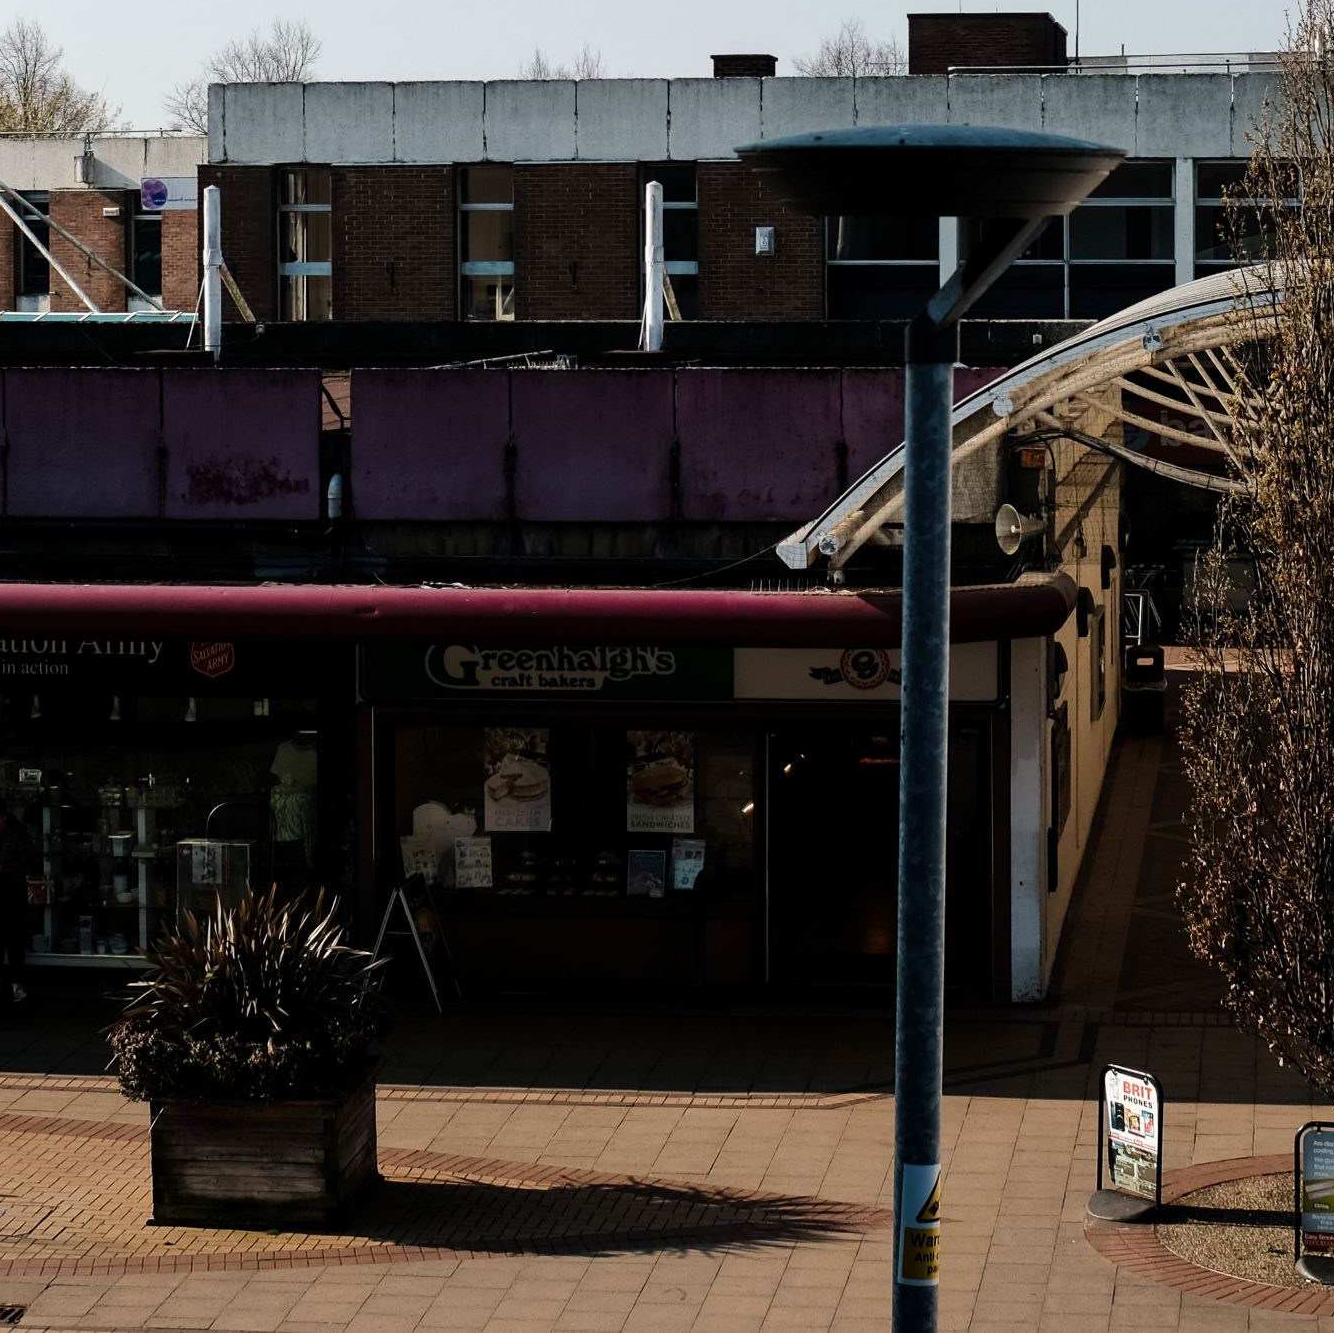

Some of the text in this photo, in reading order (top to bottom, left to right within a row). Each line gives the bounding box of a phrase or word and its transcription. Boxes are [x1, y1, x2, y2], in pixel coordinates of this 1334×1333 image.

[1, 659, 16, 674] in
[21, 659, 69, 675] action
[207, 649, 230, 671] ARMY
[491, 673, 596, 688] craft bakers
[495, 818, 540, 827] CAKES
[630, 821, 691, 829] SANDWICHES
[1123, 1081, 1153, 1100] BRIT
[1123, 1095, 1153, 1109] PHONES
[915, 1251, 935, 1262] Anti
